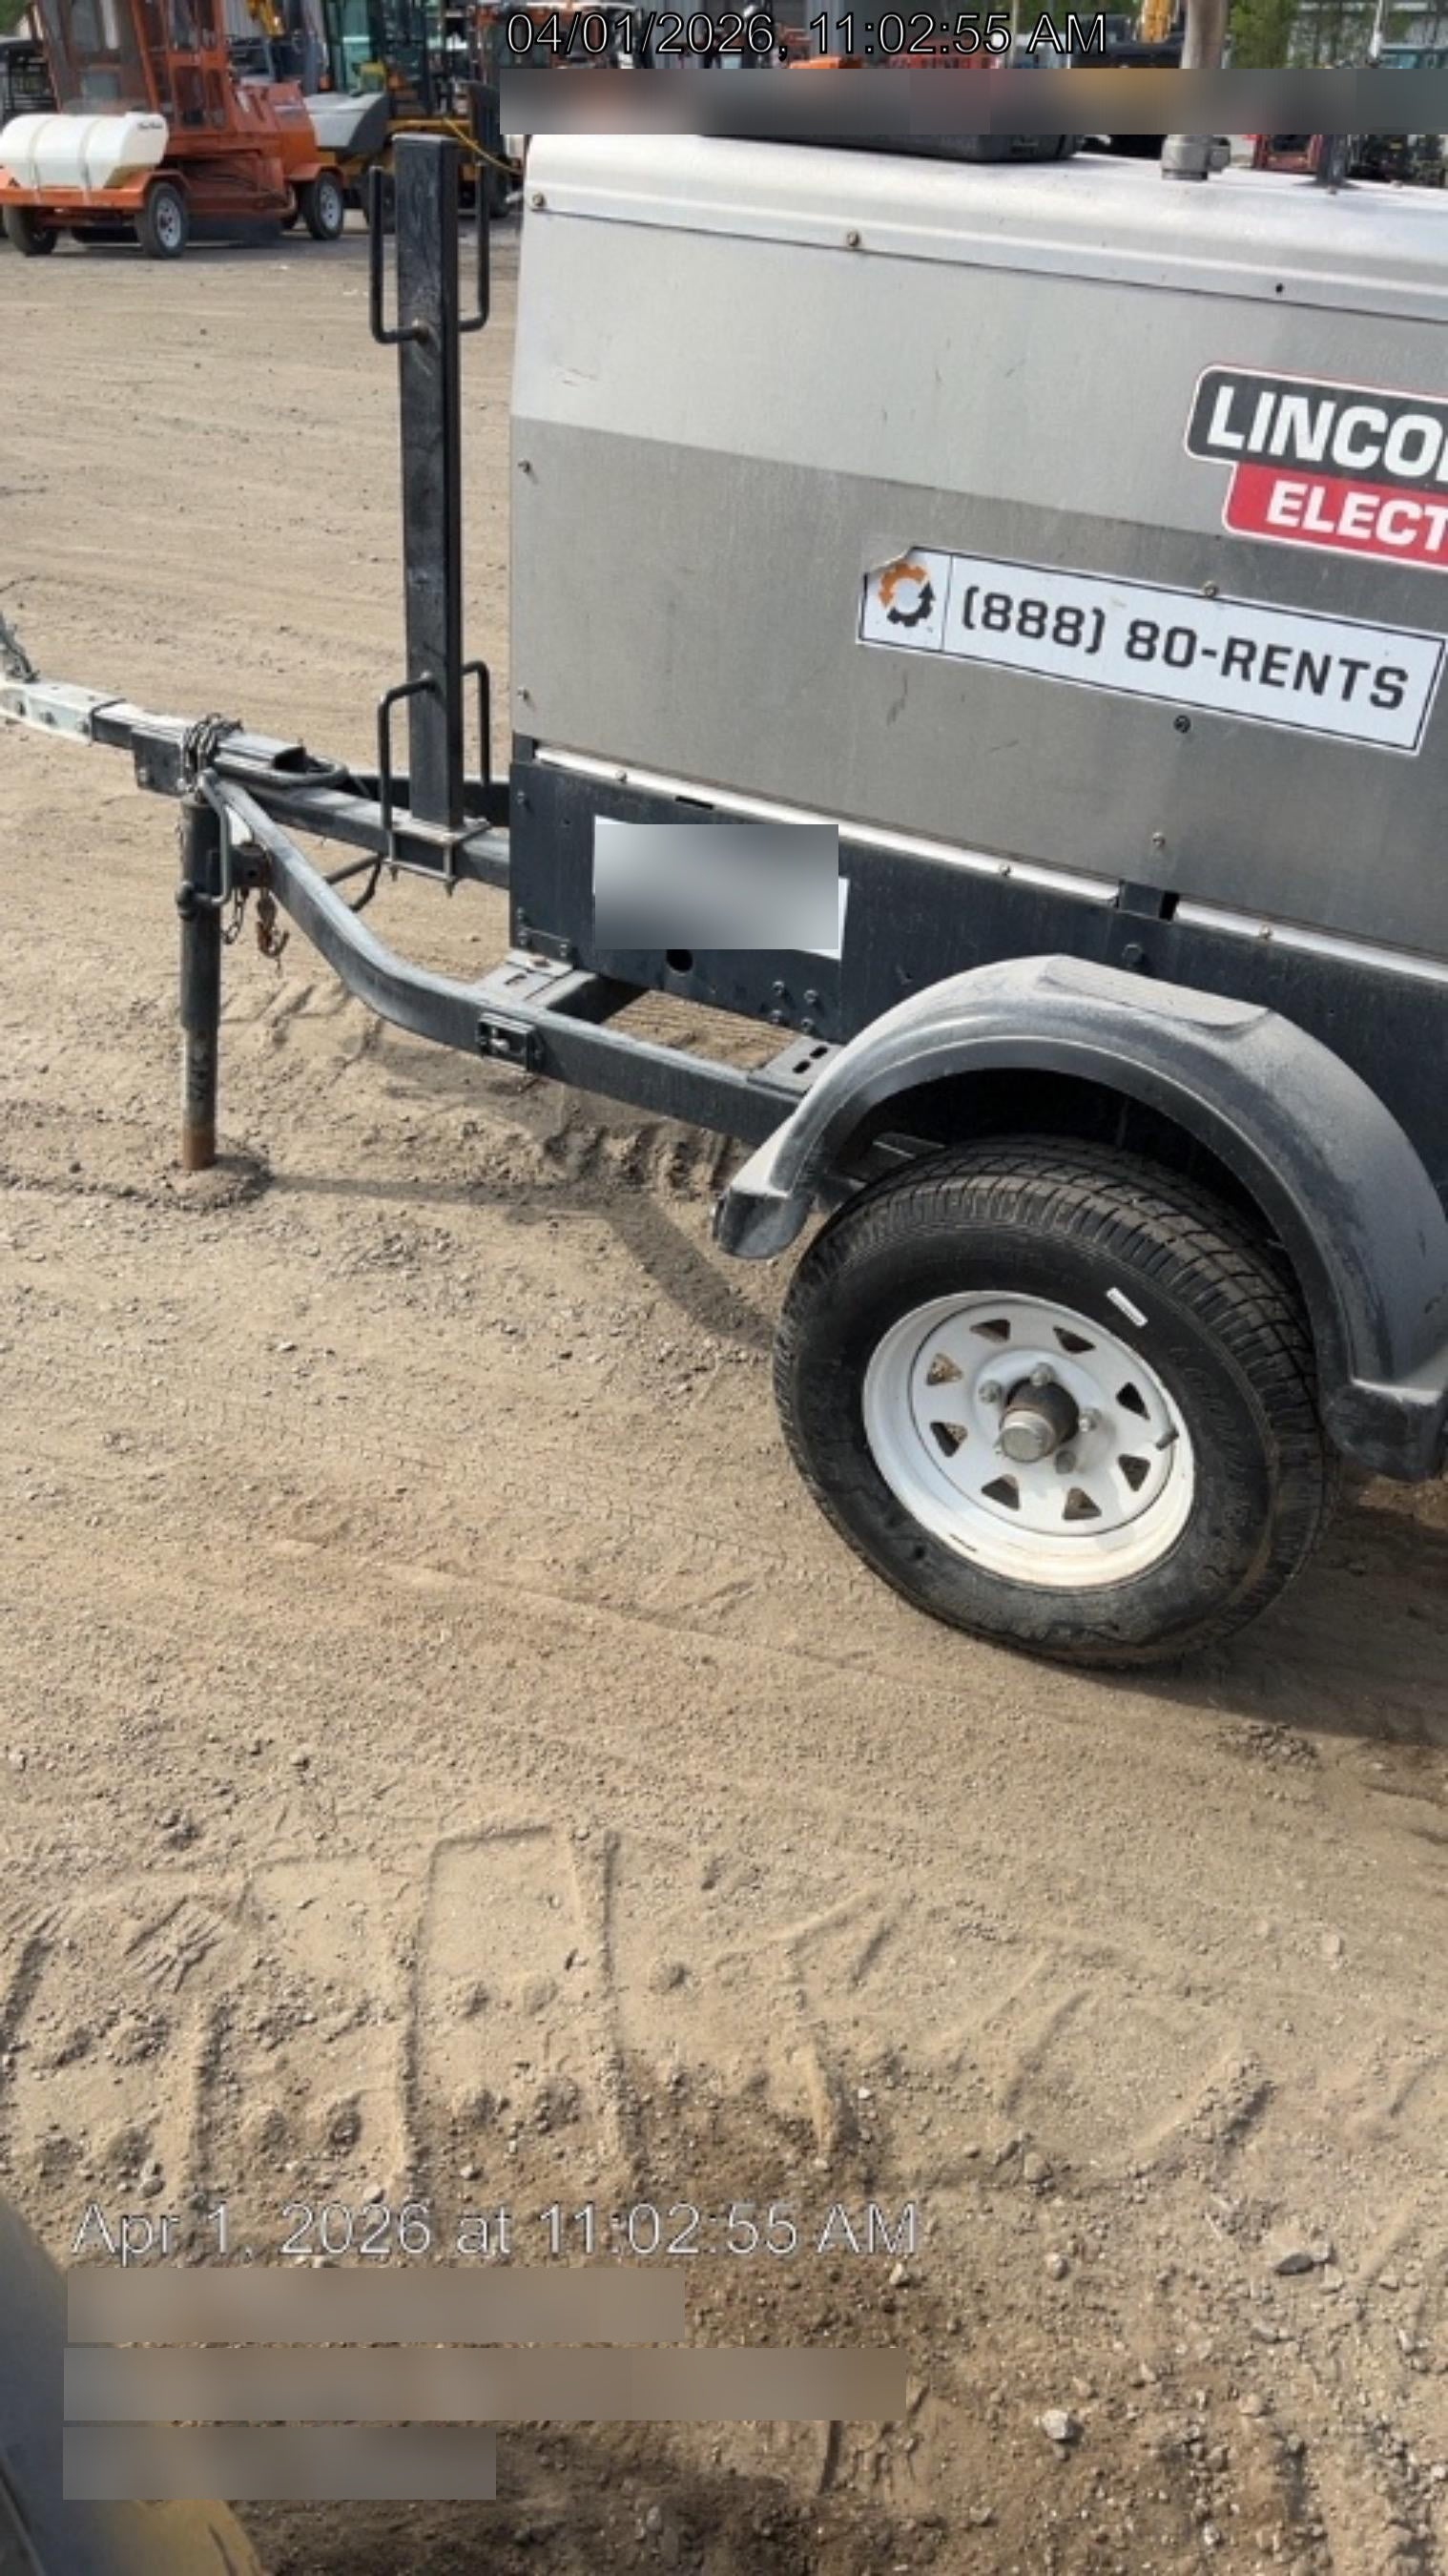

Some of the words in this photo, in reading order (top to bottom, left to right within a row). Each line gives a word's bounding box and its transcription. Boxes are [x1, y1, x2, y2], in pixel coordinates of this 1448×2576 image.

[1207, 384, 1448, 483] LINCO
[962, 585, 1107, 654] (888)
[1124, 618, 1410, 711] 80-RENTS
